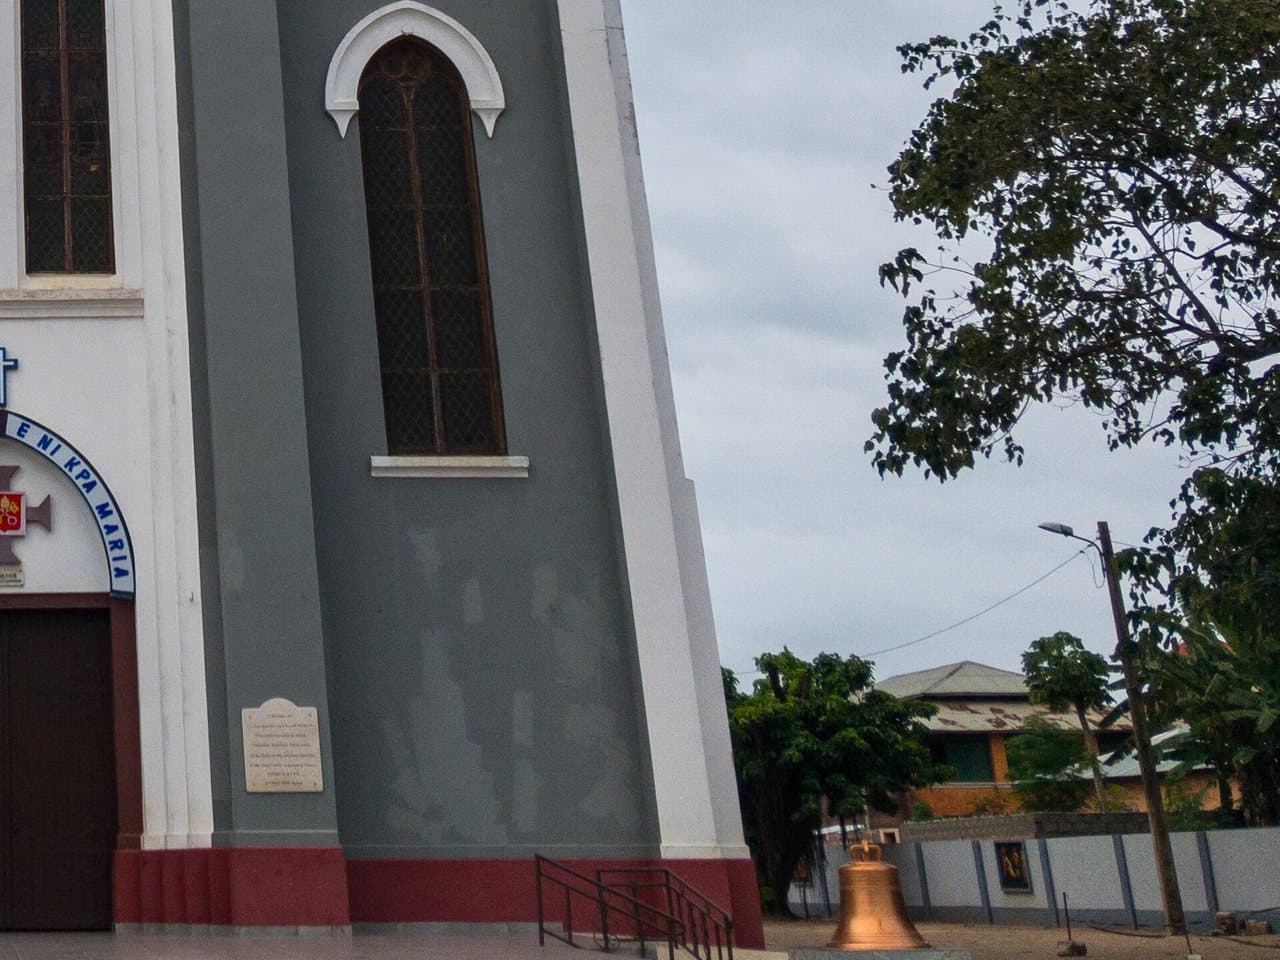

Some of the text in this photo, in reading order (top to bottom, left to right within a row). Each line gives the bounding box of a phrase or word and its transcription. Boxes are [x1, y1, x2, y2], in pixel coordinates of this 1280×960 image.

[16, 421, 130, 579] E NI KPA MARIA
